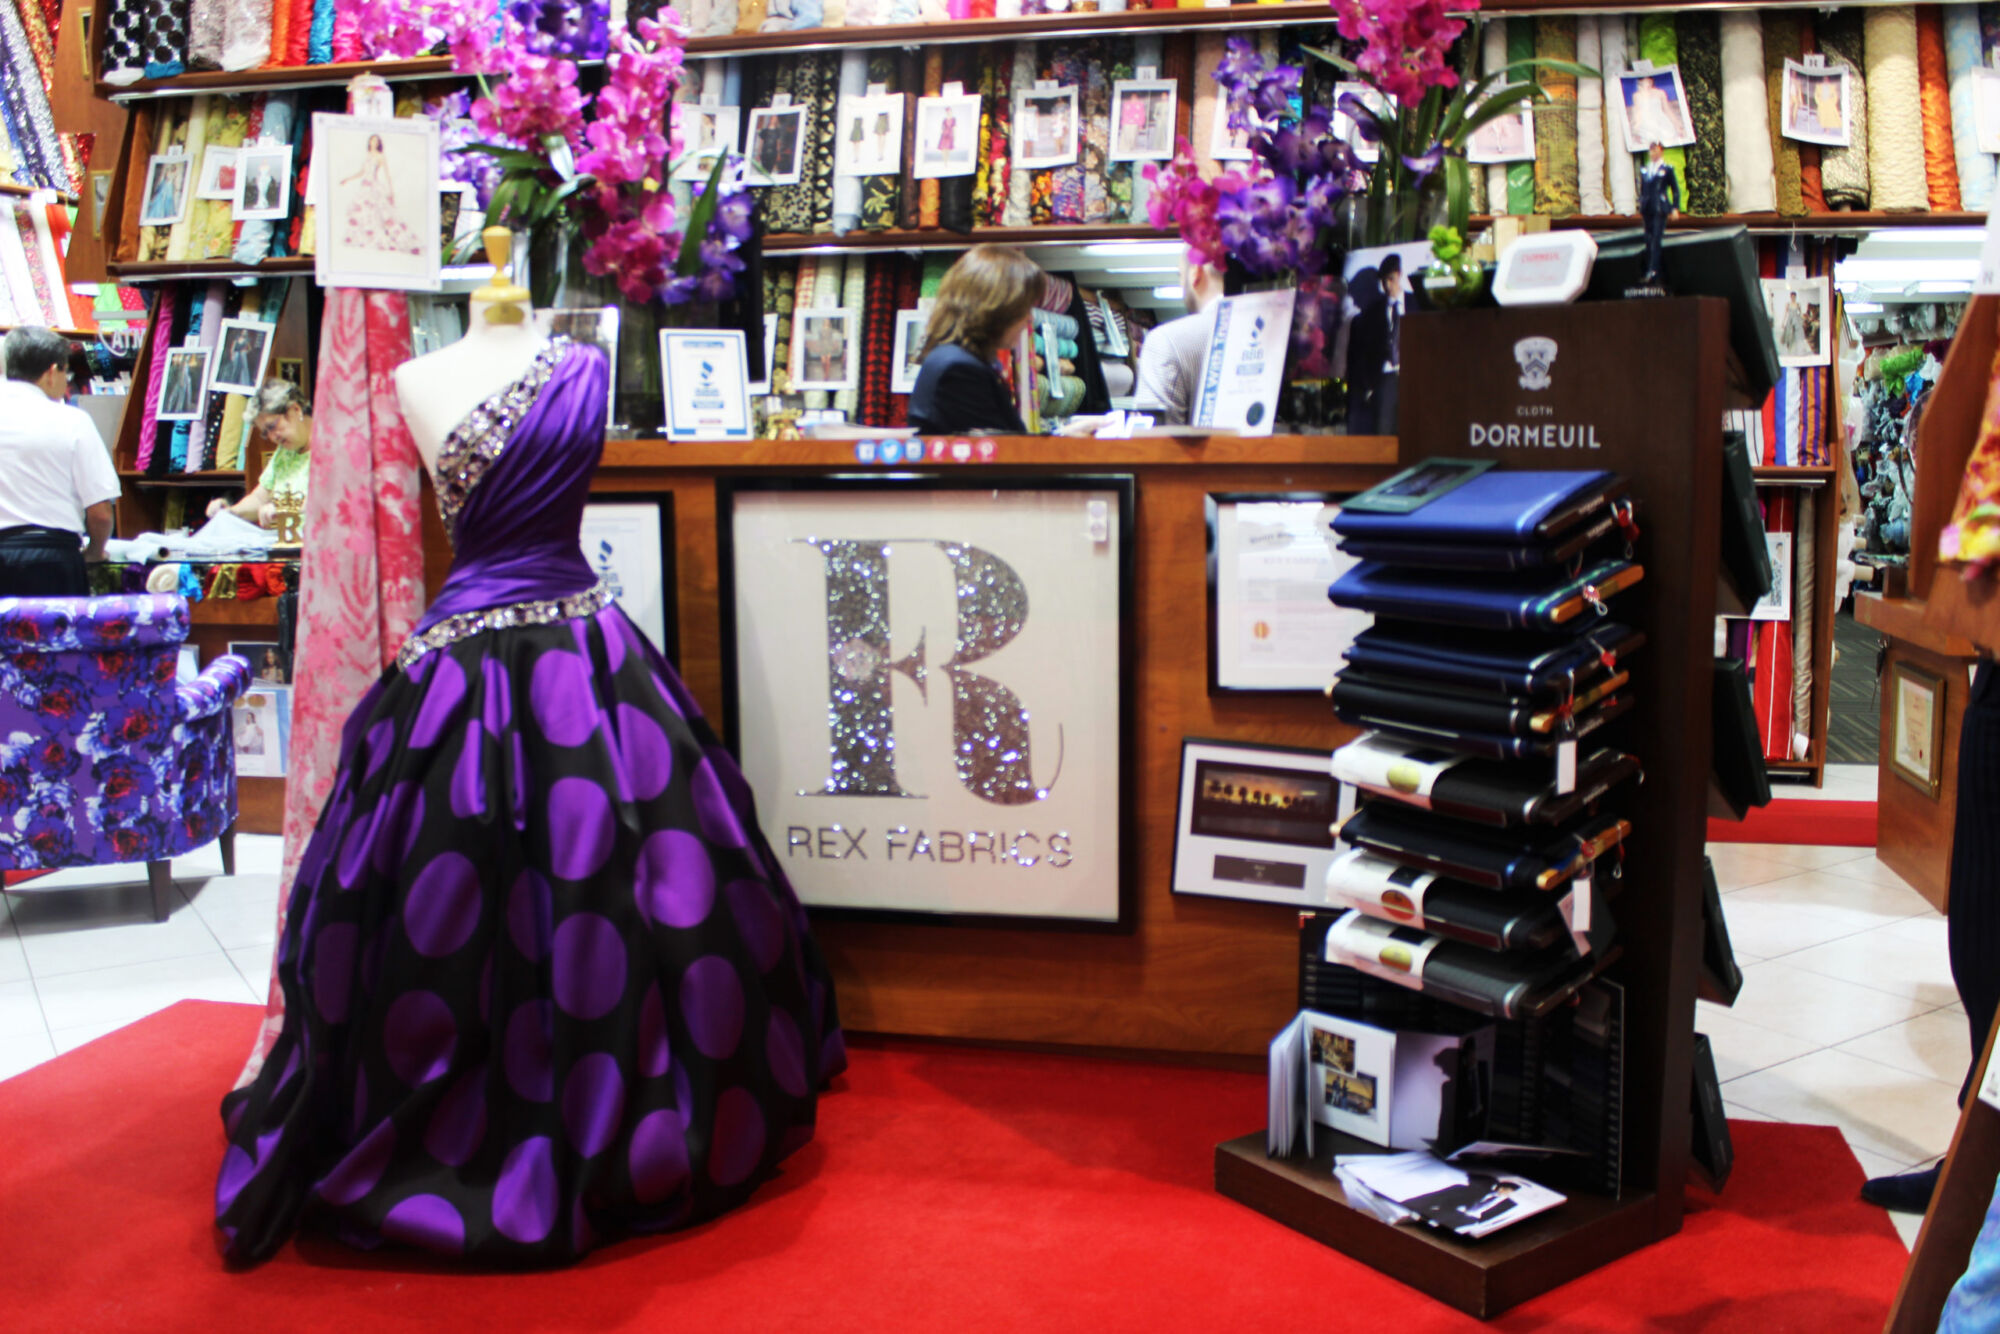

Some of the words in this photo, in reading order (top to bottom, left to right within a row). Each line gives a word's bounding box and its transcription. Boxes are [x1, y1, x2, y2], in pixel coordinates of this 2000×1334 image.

[1516, 406, 1553, 416] CLOTH
[1470, 423, 1601, 448] DORMEUIL
[787, 826, 868, 861] REX
[886, 829, 1073, 867] FABRICS
